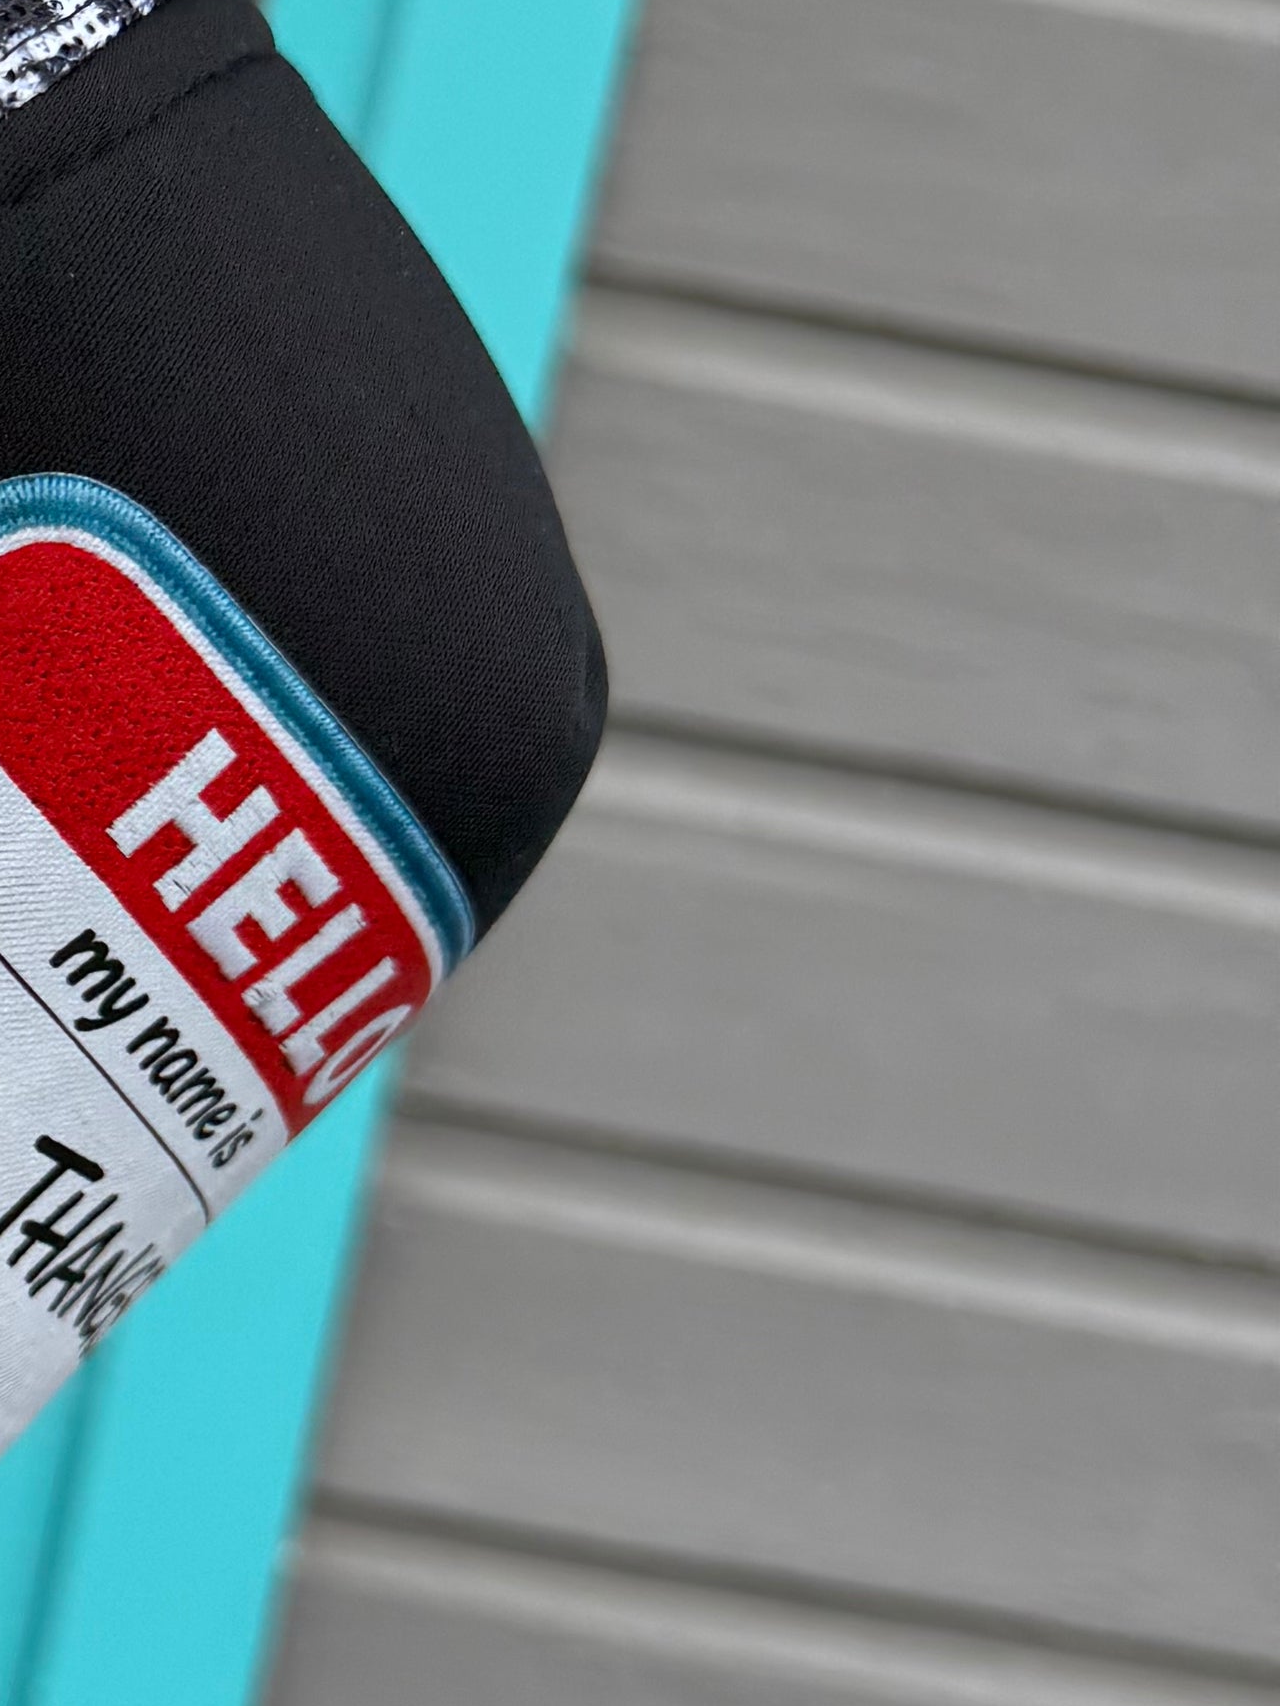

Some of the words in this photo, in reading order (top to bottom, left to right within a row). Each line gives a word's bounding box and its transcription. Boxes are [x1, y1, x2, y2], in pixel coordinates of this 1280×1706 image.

[48, 928, 151, 1033] my
[125, 1015, 227, 1141] name
[207, 1107, 264, 1169] is
[104, 727, 414, 1106] HELLO
